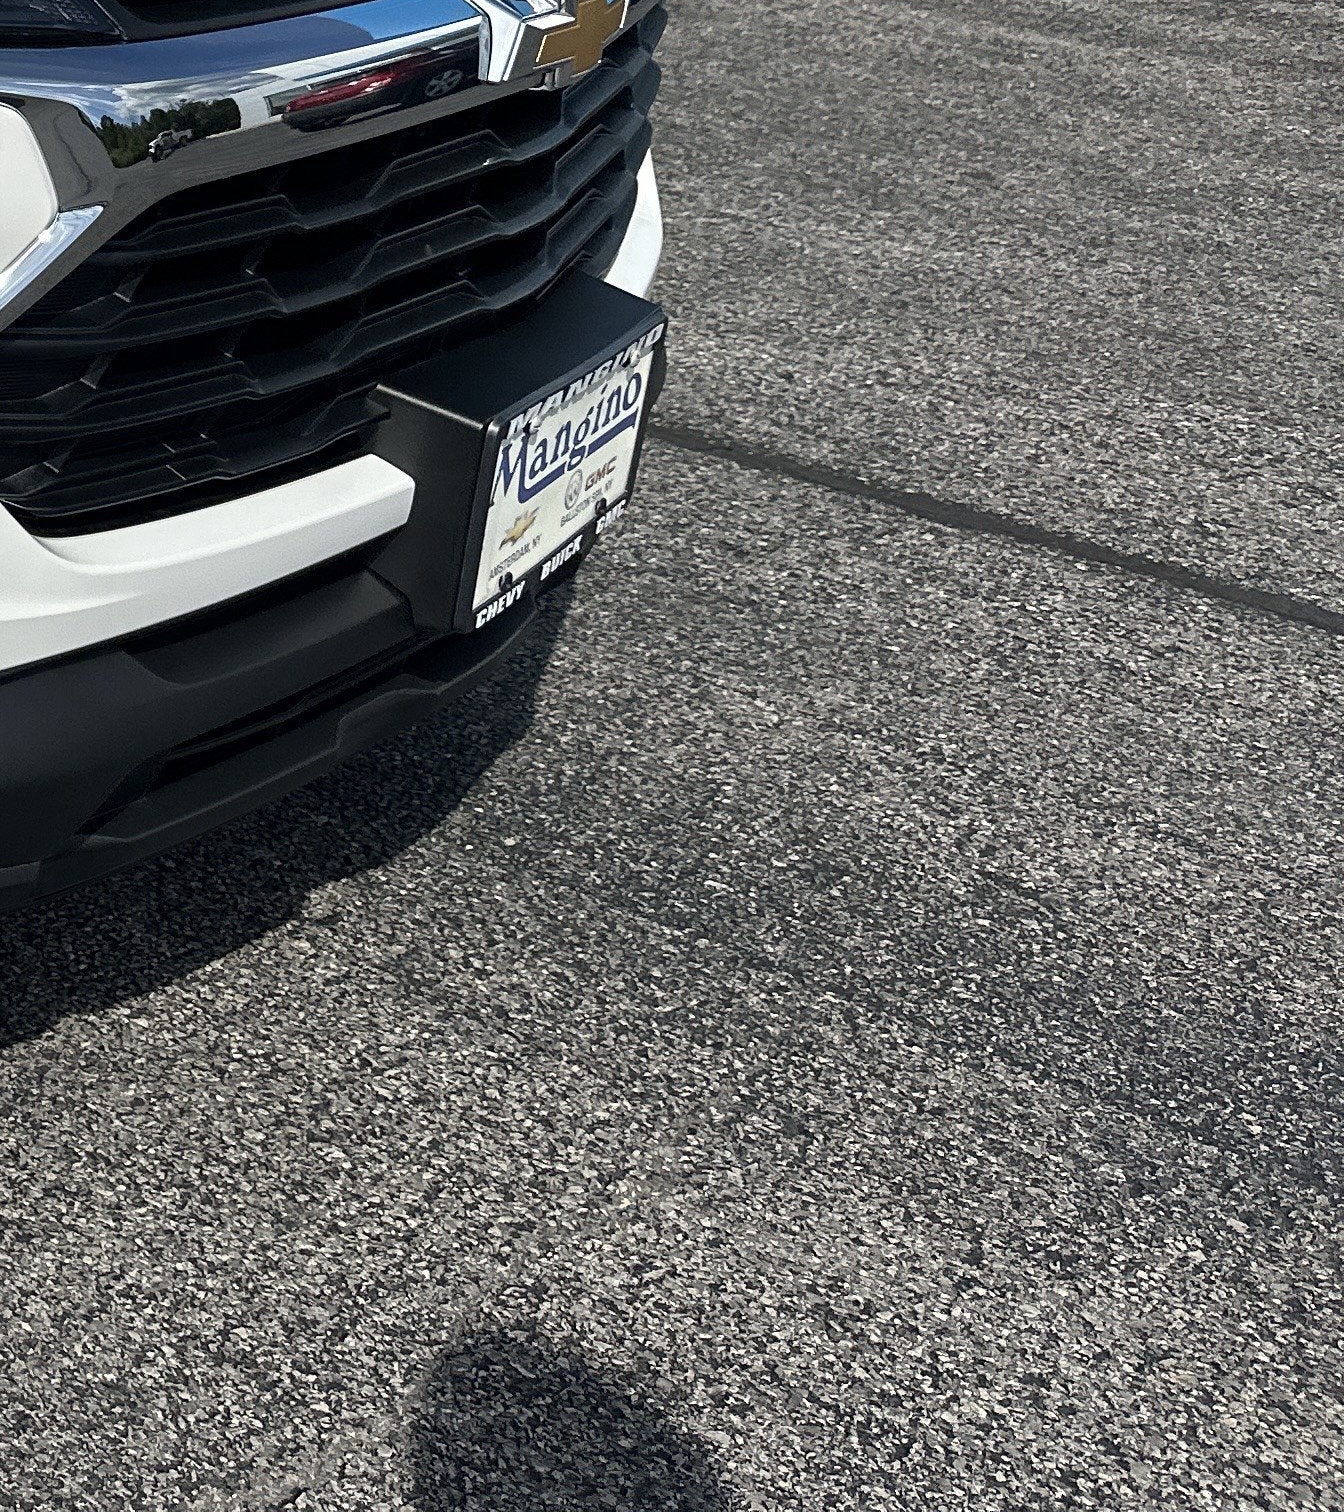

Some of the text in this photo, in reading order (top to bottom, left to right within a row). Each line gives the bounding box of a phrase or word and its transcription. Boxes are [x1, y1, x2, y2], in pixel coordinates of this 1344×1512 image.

[492, 372, 642, 503] Mangino
[506, 323, 665, 440] MANGINO
[585, 455, 617, 492] GMC
[475, 499, 627, 629] CHEVY BUICK GMC
